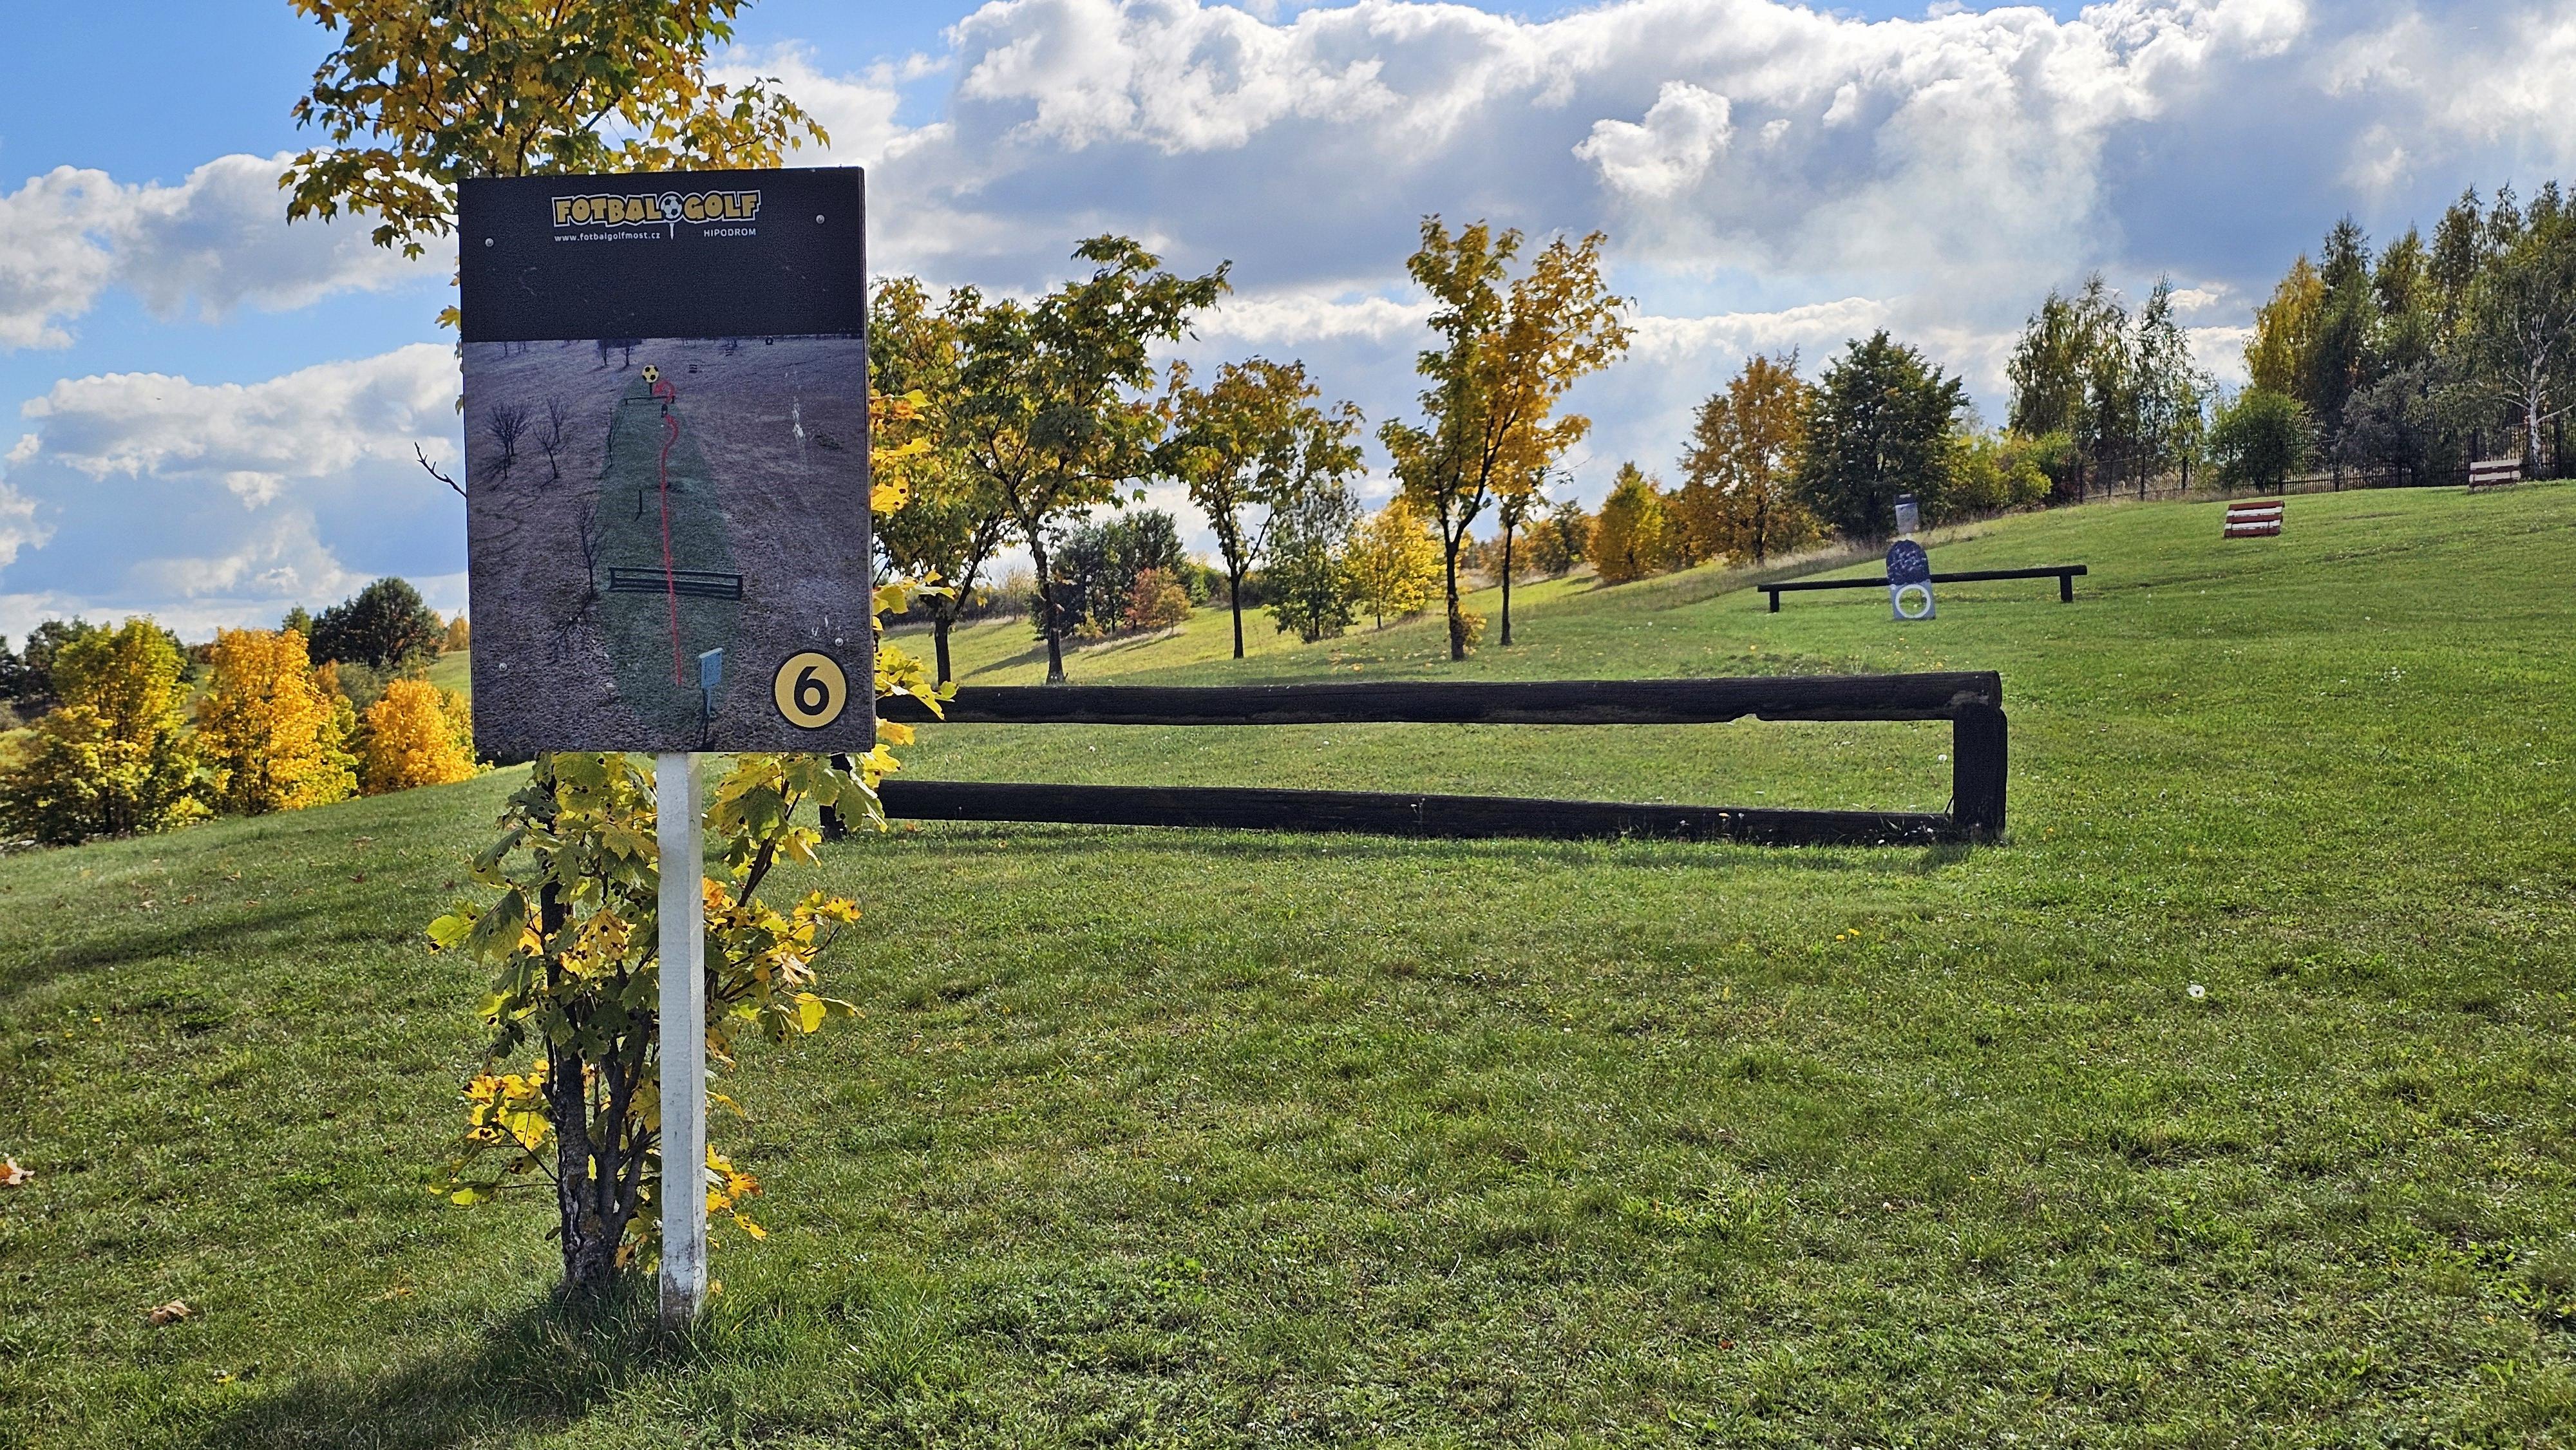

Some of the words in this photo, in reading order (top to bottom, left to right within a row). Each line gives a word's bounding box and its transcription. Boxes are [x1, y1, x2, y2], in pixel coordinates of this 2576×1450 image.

[554, 196, 662, 225] FOTBAL
[683, 193, 759, 221] GOLF
[554, 231, 661, 241] www.fotbalgolfmost.cz
[703, 228, 757, 237] HIPODROM
[793, 666, 829, 716] 6
